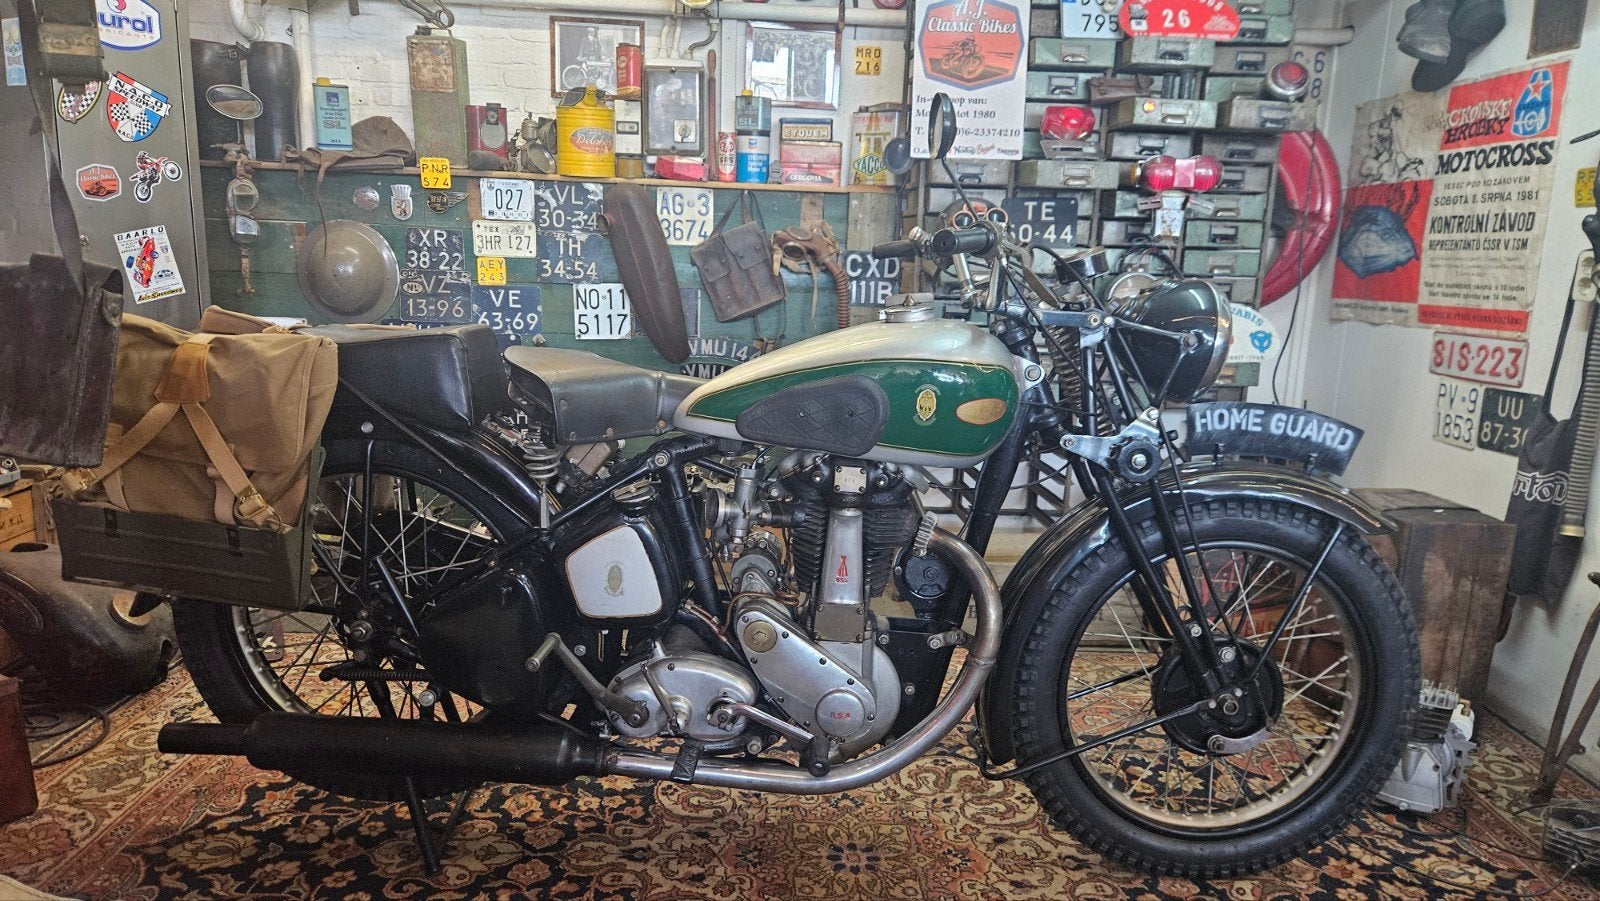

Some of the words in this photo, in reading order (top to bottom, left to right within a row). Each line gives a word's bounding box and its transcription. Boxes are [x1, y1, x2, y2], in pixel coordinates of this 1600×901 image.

[98, 12, 153, 34] urol
[928, 16, 976, 33] Classic
[979, 18, 1017, 34] Bikes
[1162, 9, 1191, 28] 26
[855, 61, 880, 72] 716
[968, 97, 988, 105] van:
[973, 110, 996, 119] 1980
[915, 126, 925, 135] T.
[1435, 140, 1555, 175] MOTOCROSS
[424, 177, 449, 187] 574
[495, 188, 523, 210] 027
[554, 185, 584, 205] VL
[661, 192, 685, 215] AG
[698, 193, 710, 216] 3
[1434, 196, 1468, 206] SOBOTA
[1481, 192, 1512, 203] SRPNA
[1517, 190, 1539, 201] 1981
[539, 209, 598, 230] 30-34
[1024, 201, 1055, 220] TE
[660, 218, 709, 241] 3674
[1429, 210, 1490, 234] KONTROLNÍ
[1492, 208, 1536, 232] ZÁVOD
[418, 229, 448, 248] XR
[477, 235, 501, 250] 3HR
[509, 235, 531, 250] 127
[556, 235, 581, 257] TH
[406, 250, 462, 270] 38-22
[541, 259, 598, 279] 34-54
[846, 254, 900, 278] CXD
[421, 274, 450, 293] VZ
[480, 273, 504, 281] 243
[407, 298, 465, 318] 13-96
[489, 290, 521, 308] VE
[576, 288, 600, 309] NO
[607, 288, 626, 309] 11
[478, 310, 539, 331] 63-69
[578, 313, 628, 335] 5117
[688, 338, 727, 357] VMU
[1437, 383, 1459, 411] PV
[1467, 388, 1478, 413] 9
[1498, 396, 1523, 419] UU
[1195, 408, 1265, 432] HOME
[1270, 412, 1354, 451] GUARD
[1436, 411, 1474, 443] 1853
[1514, 474, 1568, 505] rton
